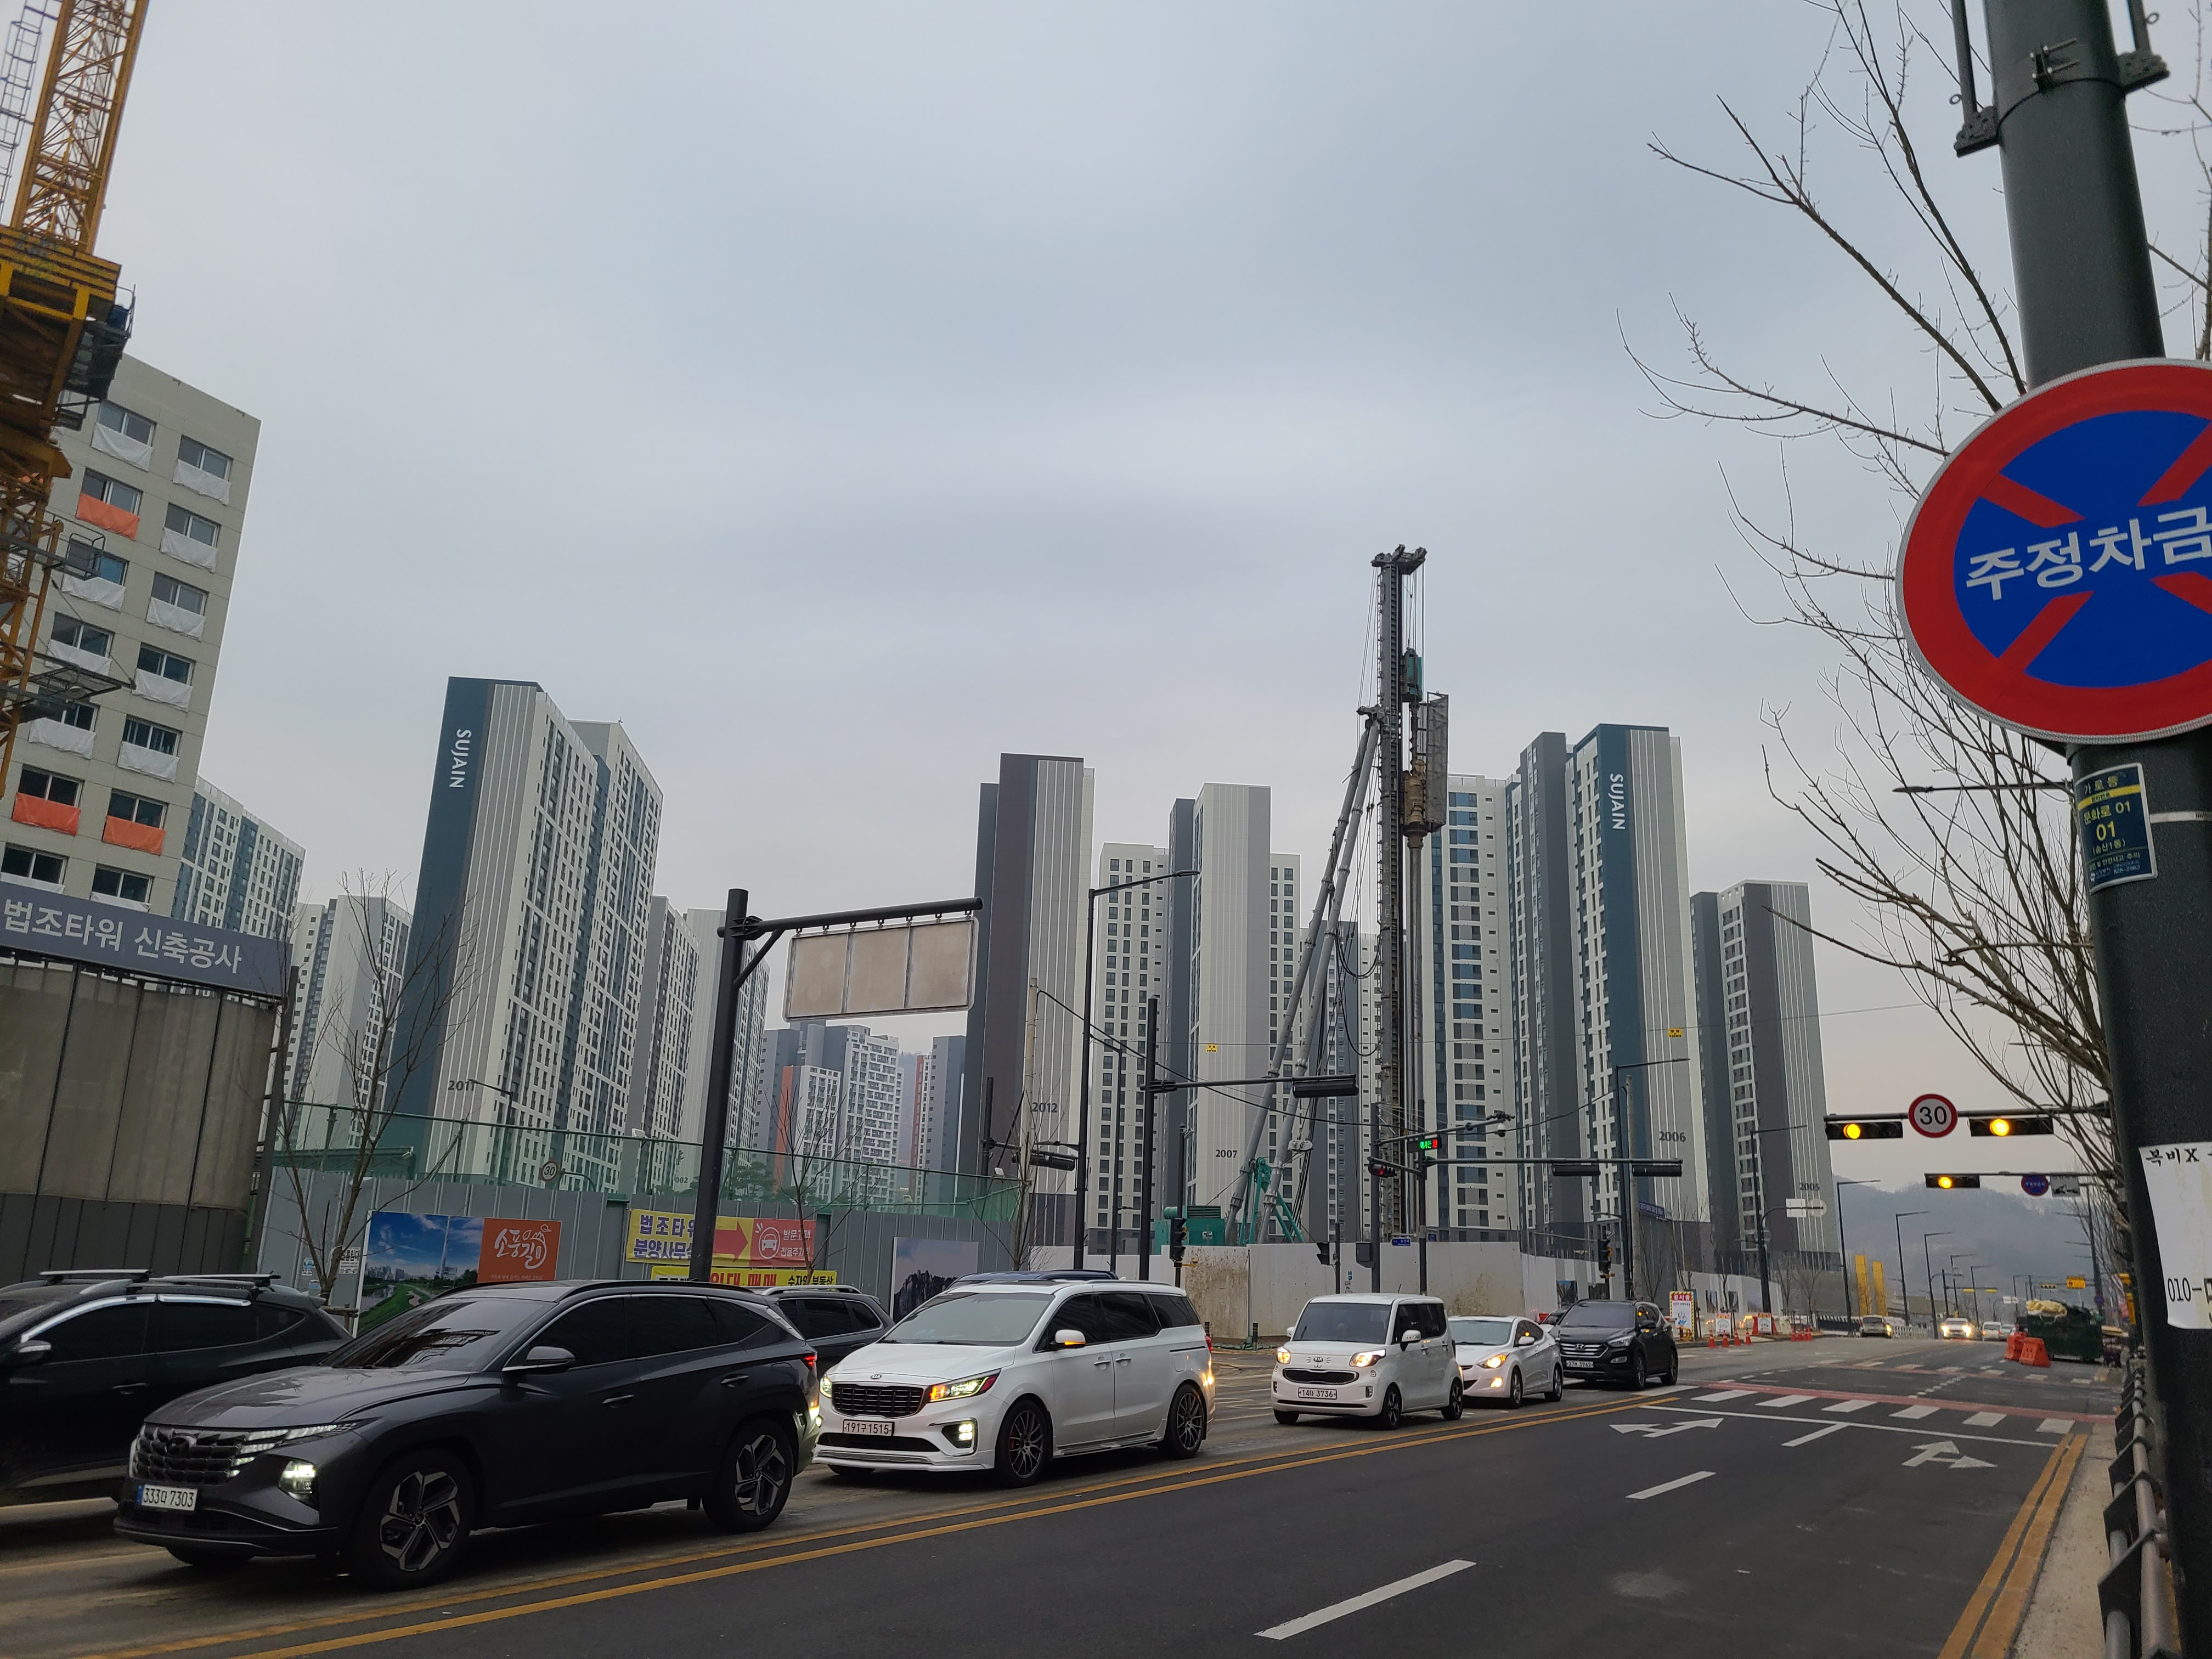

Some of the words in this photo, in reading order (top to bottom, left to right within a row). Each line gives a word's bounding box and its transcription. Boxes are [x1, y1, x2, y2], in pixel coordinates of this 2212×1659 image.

[1966, 506, 2212, 601] 주정차금
[448, 728, 472, 788] SUJAIN
[1607, 772, 1626, 830] SUJAIN
[2115, 800, 2131, 814] 01
[2096, 821, 2116, 842] 01
[3, 898, 123, 952] 법조타워
[134, 926, 242, 974] 신축공사
[1031, 1102, 1058, 1113] 2012
[1919, 1105, 1947, 1125] 30
[1658, 1131, 1686, 1143] 2006
[1215, 1149, 1238, 1158] 2007
[544, 1166, 555, 1176] 30
[1799, 1182, 1820, 1191] 2005
[847, 1422, 867, 1433] 191구
[868, 1423, 889, 1434] 1515
[170, 1490, 195, 1508] 7303
